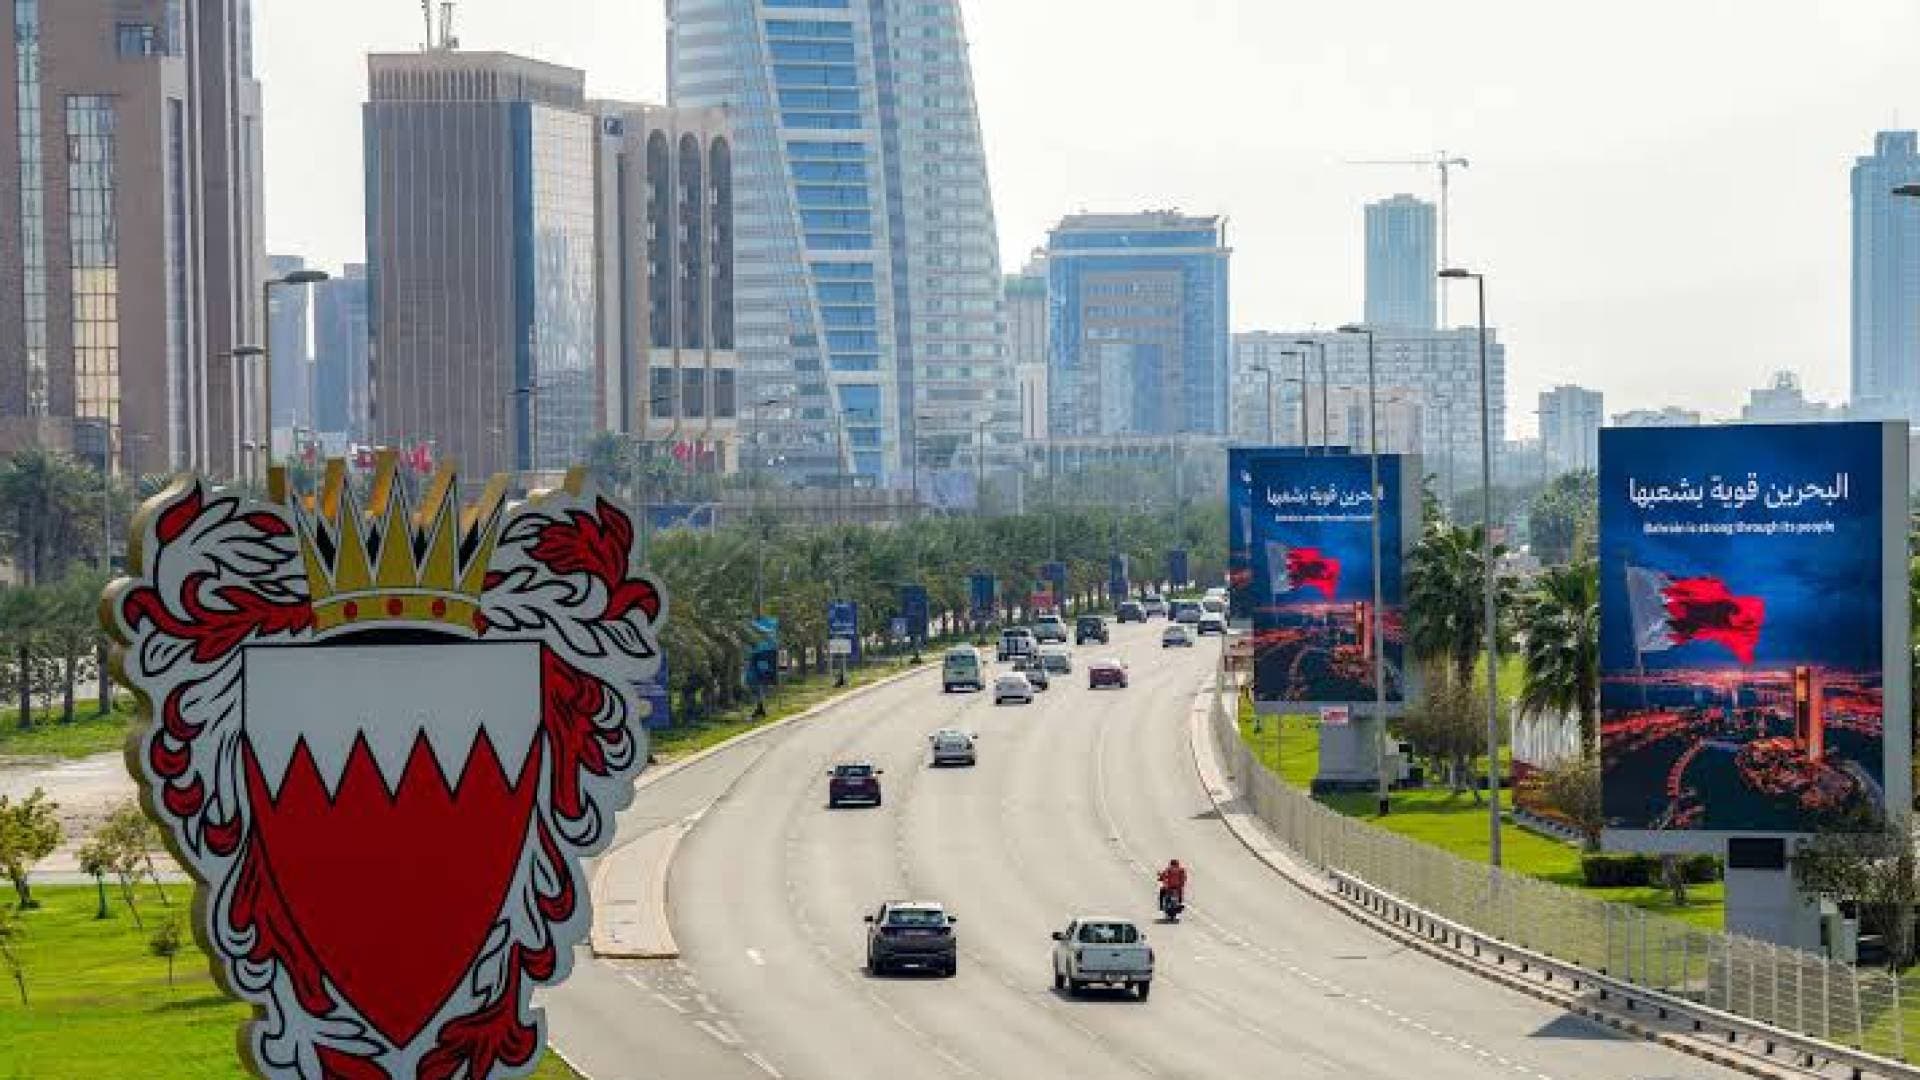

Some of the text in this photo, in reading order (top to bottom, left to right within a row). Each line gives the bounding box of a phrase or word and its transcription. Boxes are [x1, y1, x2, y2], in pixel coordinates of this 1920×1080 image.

[1629, 472, 1849, 509] البحرين قوية بشعبها
